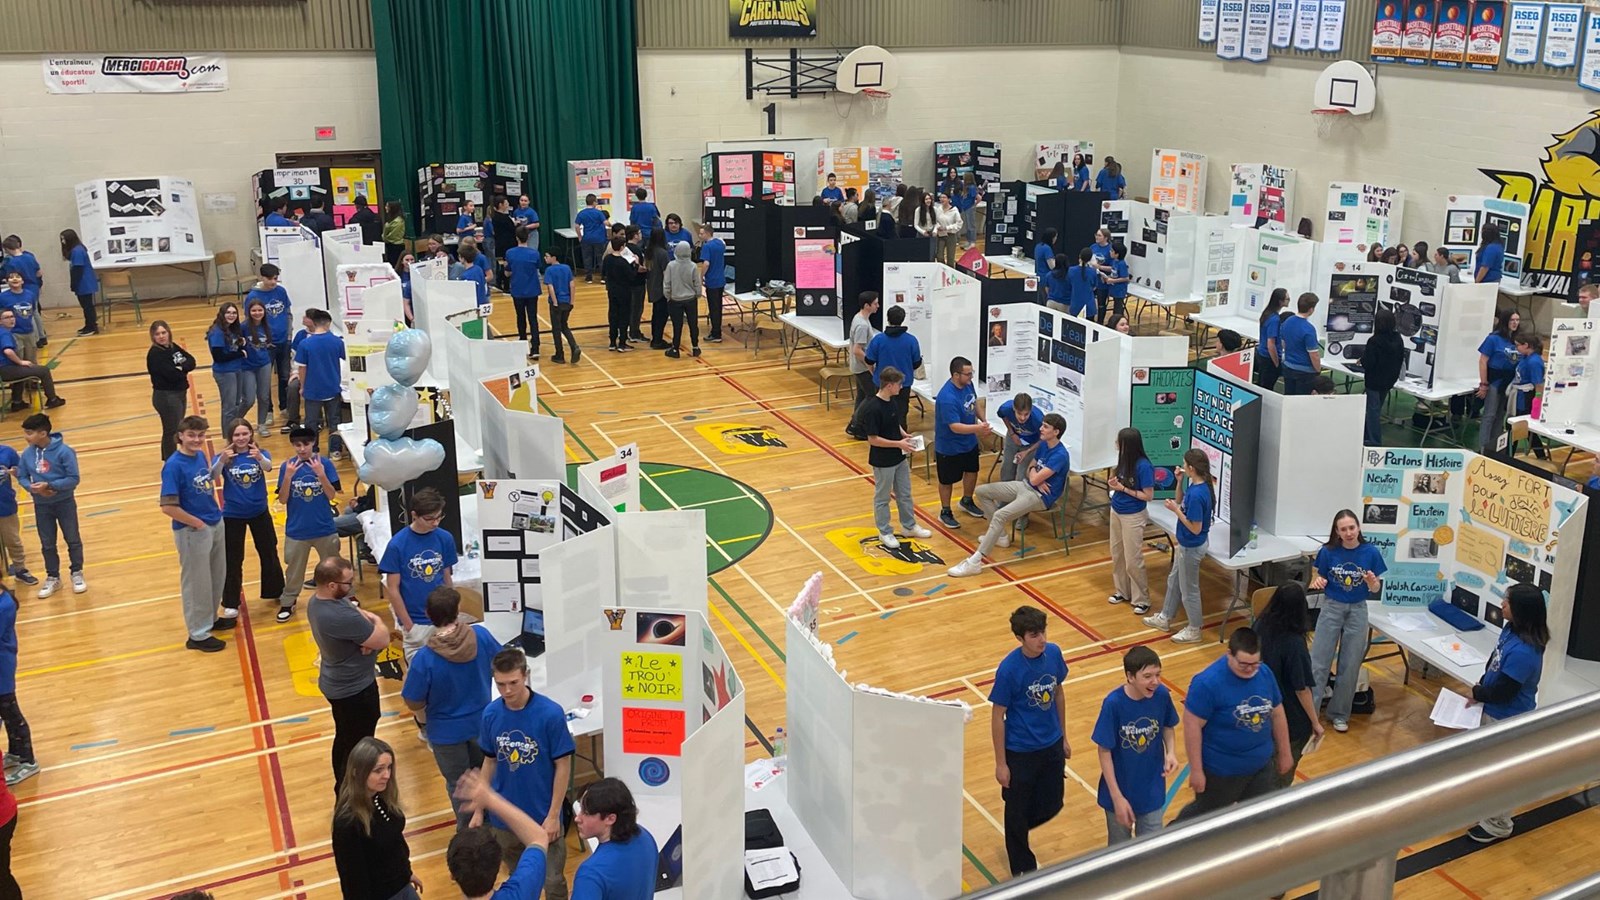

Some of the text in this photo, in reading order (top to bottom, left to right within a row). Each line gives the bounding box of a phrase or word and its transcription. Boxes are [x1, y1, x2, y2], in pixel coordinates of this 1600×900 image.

[740, 0, 810, 26] CARCAJOUS
[1514, 11, 1539, 20] RSEQ
[1551, 12, 1578, 22] RSEQ
[60, 68, 96, 76] éducateur
[763, 103, 776, 134] 1
[1363, 184, 1372, 194] LE
[1364, 196, 1377, 205] DES
[482, 306, 491, 314] 32
[1583, 322, 1593, 330] 13
[524, 368, 536, 378] 33
[1219, 382, 1232, 398] LE
[620, 448, 632, 459] 34
[1384, 452, 1422, 466] Parlons
[1426, 454, 1462, 468] Histoire
[1366, 473, 1398, 483] Newton
[1518, 474, 1552, 498] FORT
[1472, 484, 1498, 500] pour
[1470, 498, 1486, 518] la
[1386, 580, 1446, 592] Walsh Carswell
[638, 655, 662, 670] Le
[629, 671, 666, 682] TROU
[638, 682, 677, 695] NOIR
